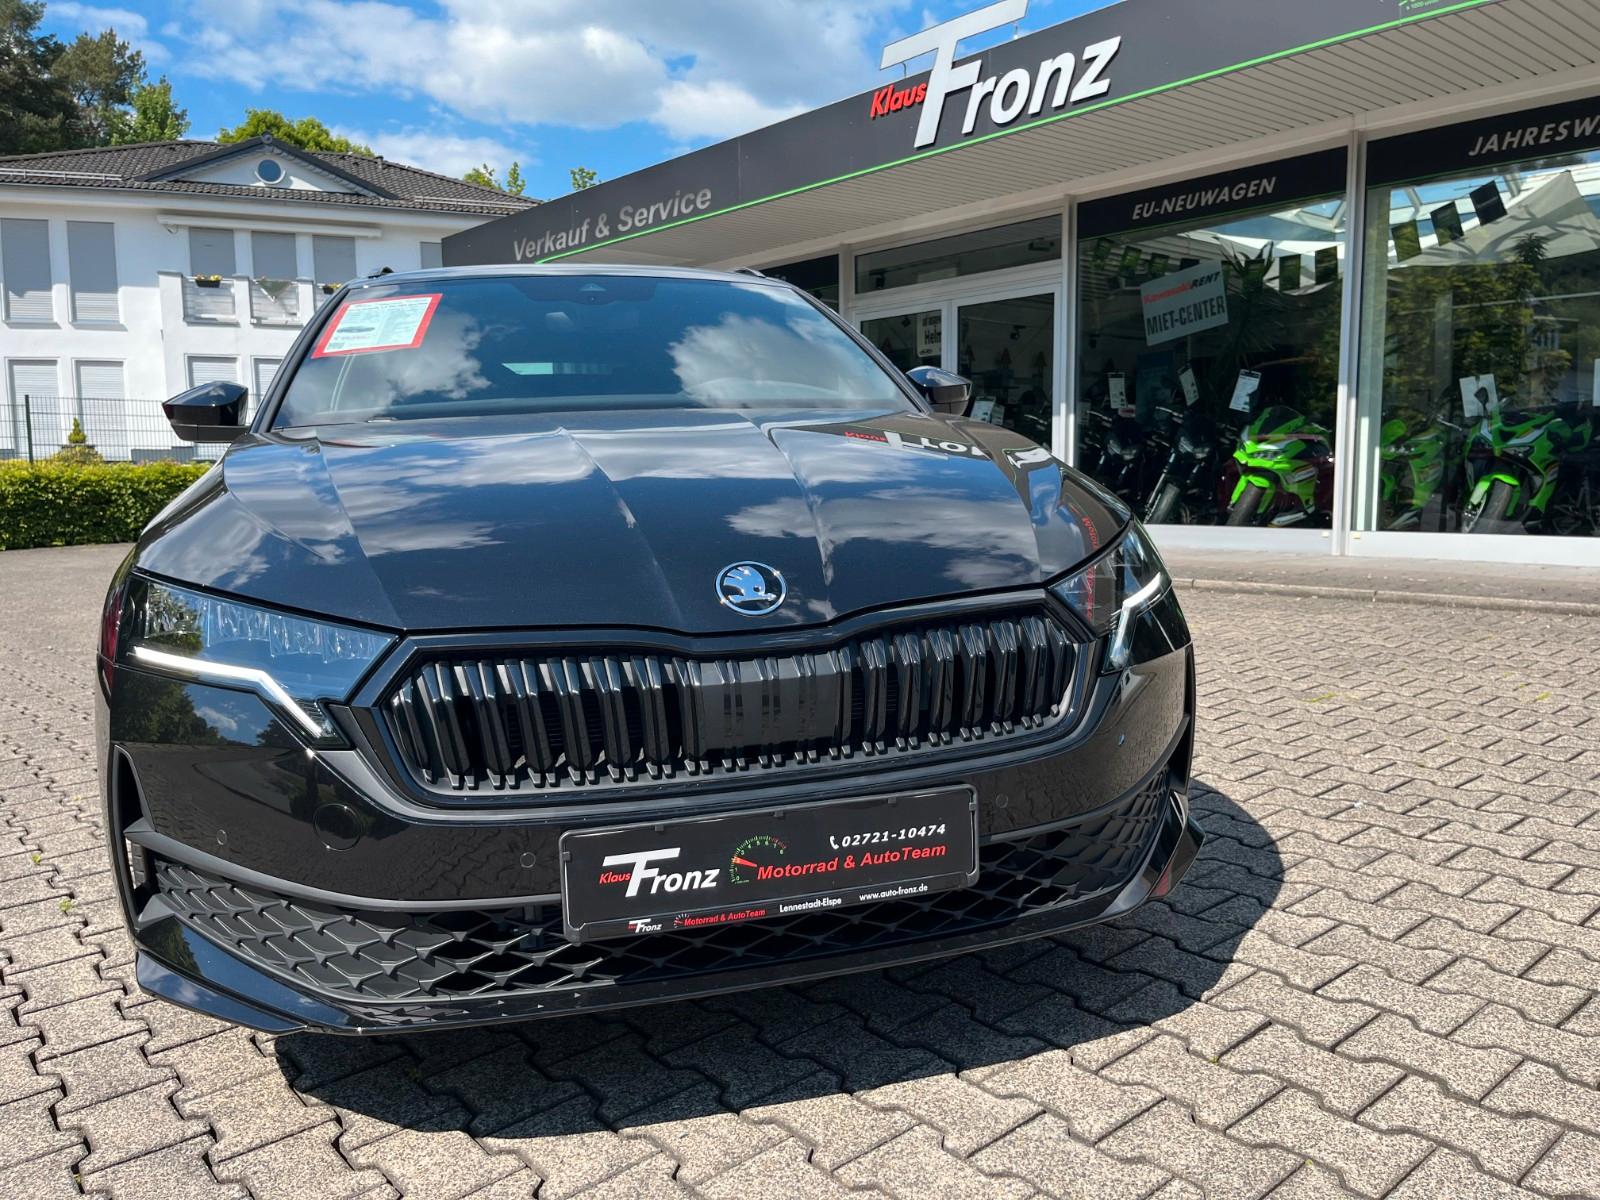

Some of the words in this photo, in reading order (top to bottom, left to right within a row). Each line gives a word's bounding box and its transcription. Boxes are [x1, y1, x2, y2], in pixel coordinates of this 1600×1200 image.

[880, 0, 1121, 148] Fronz
[870, 82, 927, 119] Klaus
[1468, 114, 1600, 156] JAHRESW
[1131, 176, 1277, 221] EU-NEUWAGEN
[513, 218, 591, 262] Verkauf
[595, 213, 610, 239] &
[617, 187, 712, 232] Service
[1146, 295, 1226, 337] MIET-CENTER
[841, 823, 946, 848] 02721-10474
[600, 871, 632, 884] Klaus
[602, 847, 720, 898] Fronz
[757, 857, 839, 880] Motorrad
[843, 856, 855, 870] &
[779, 896, 842, 913] Lennestadt-Elspe
[859, 883, 929, 902] www.auto-fronz.de
[628, 918, 662, 933] Fronz
[684, 914, 719, 926] Motorrad
[720, 913, 726, 922] &
